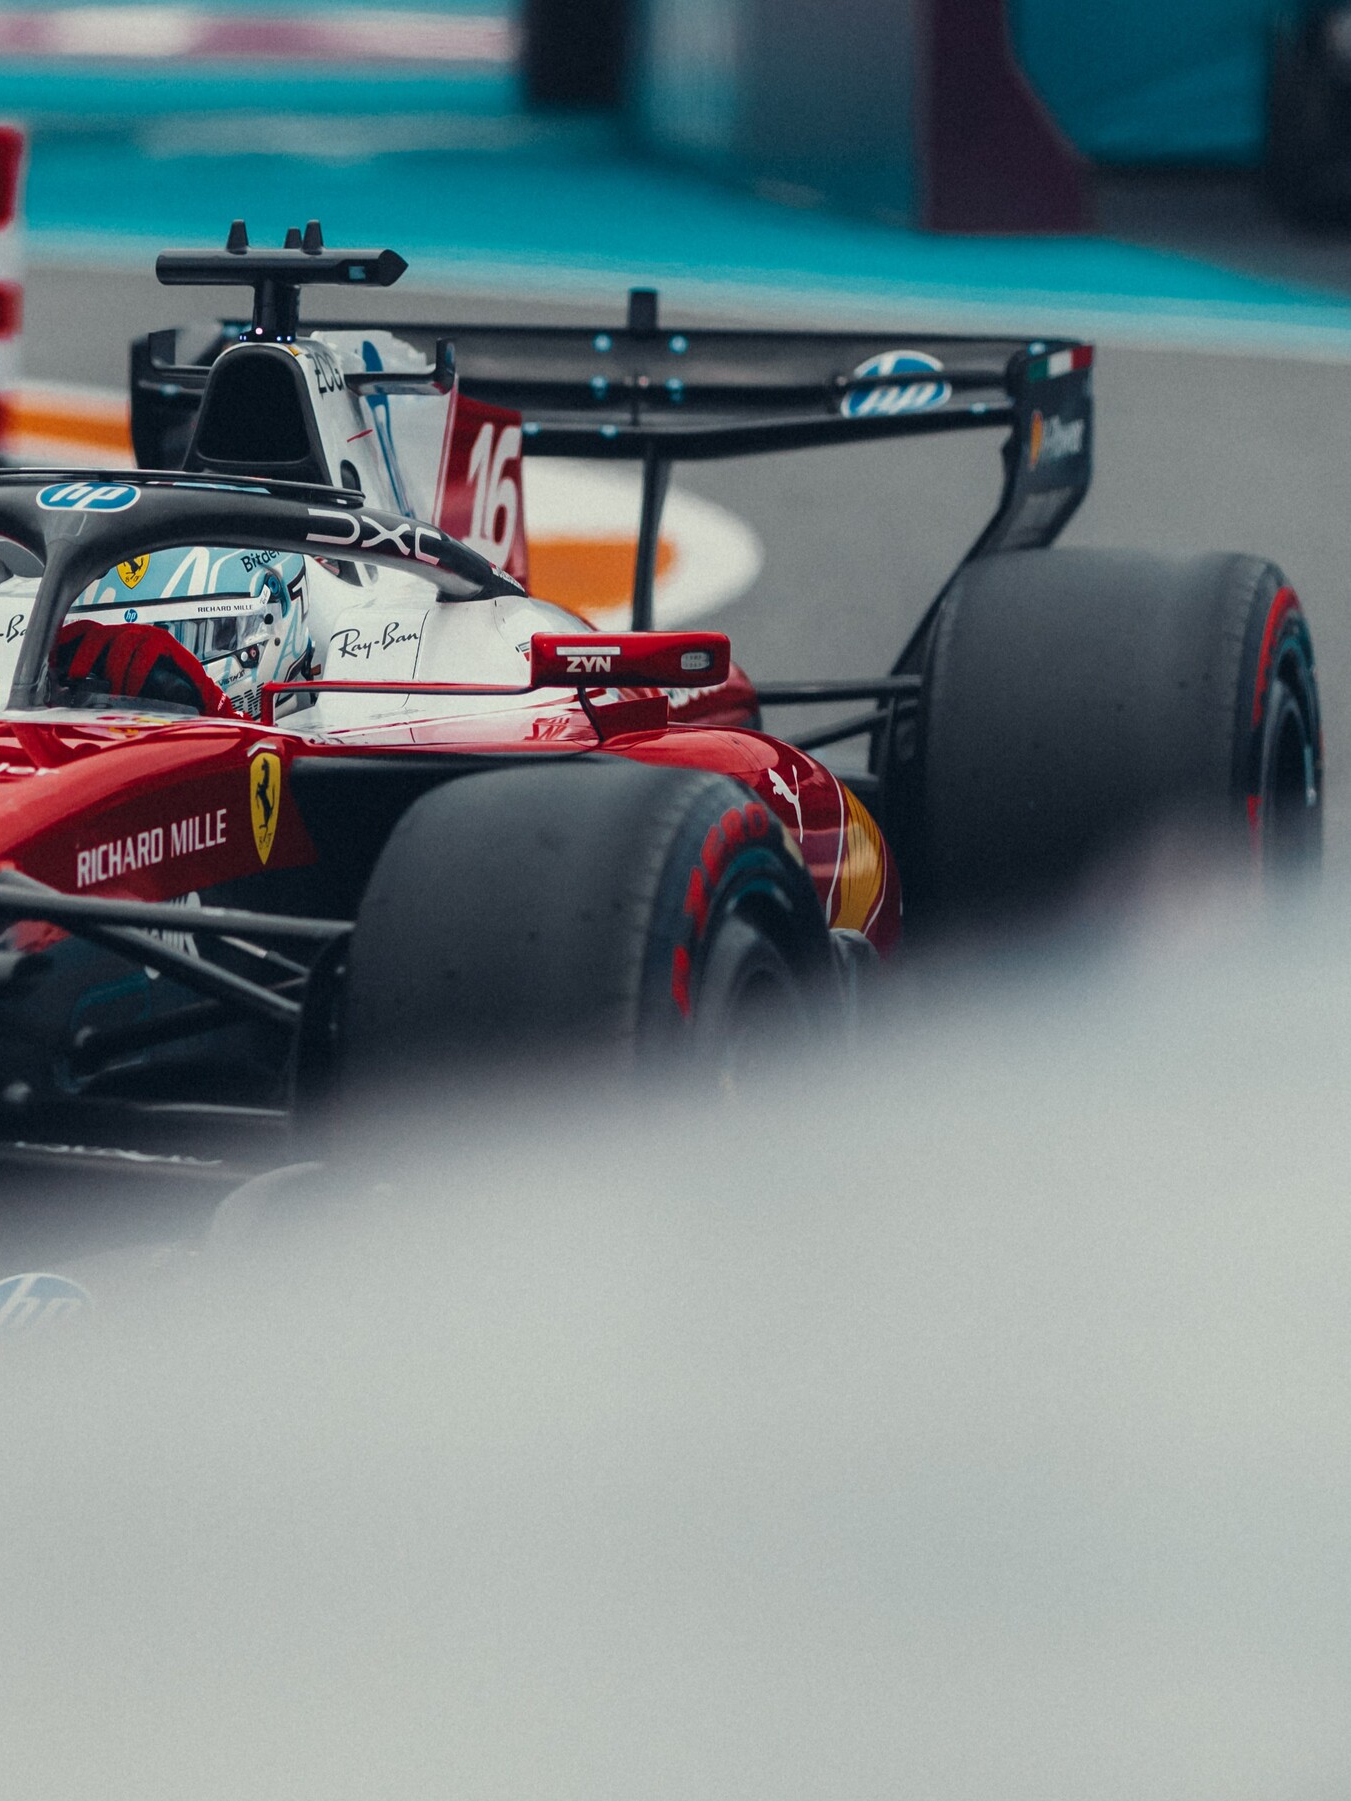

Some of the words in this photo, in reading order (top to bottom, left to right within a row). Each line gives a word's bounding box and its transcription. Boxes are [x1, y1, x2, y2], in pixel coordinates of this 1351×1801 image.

[462, 422, 523, 571] 16
[306, 508, 442, 565] DXC
[125, 609, 138, 623] hp
[197, 605, 231, 613] RICHARD
[330, 621, 419, 659] Ray-Ban
[566, 656, 611, 673] ZYN
[77, 826, 164, 888] RICHARD
[170, 808, 227, 858] MILLE
